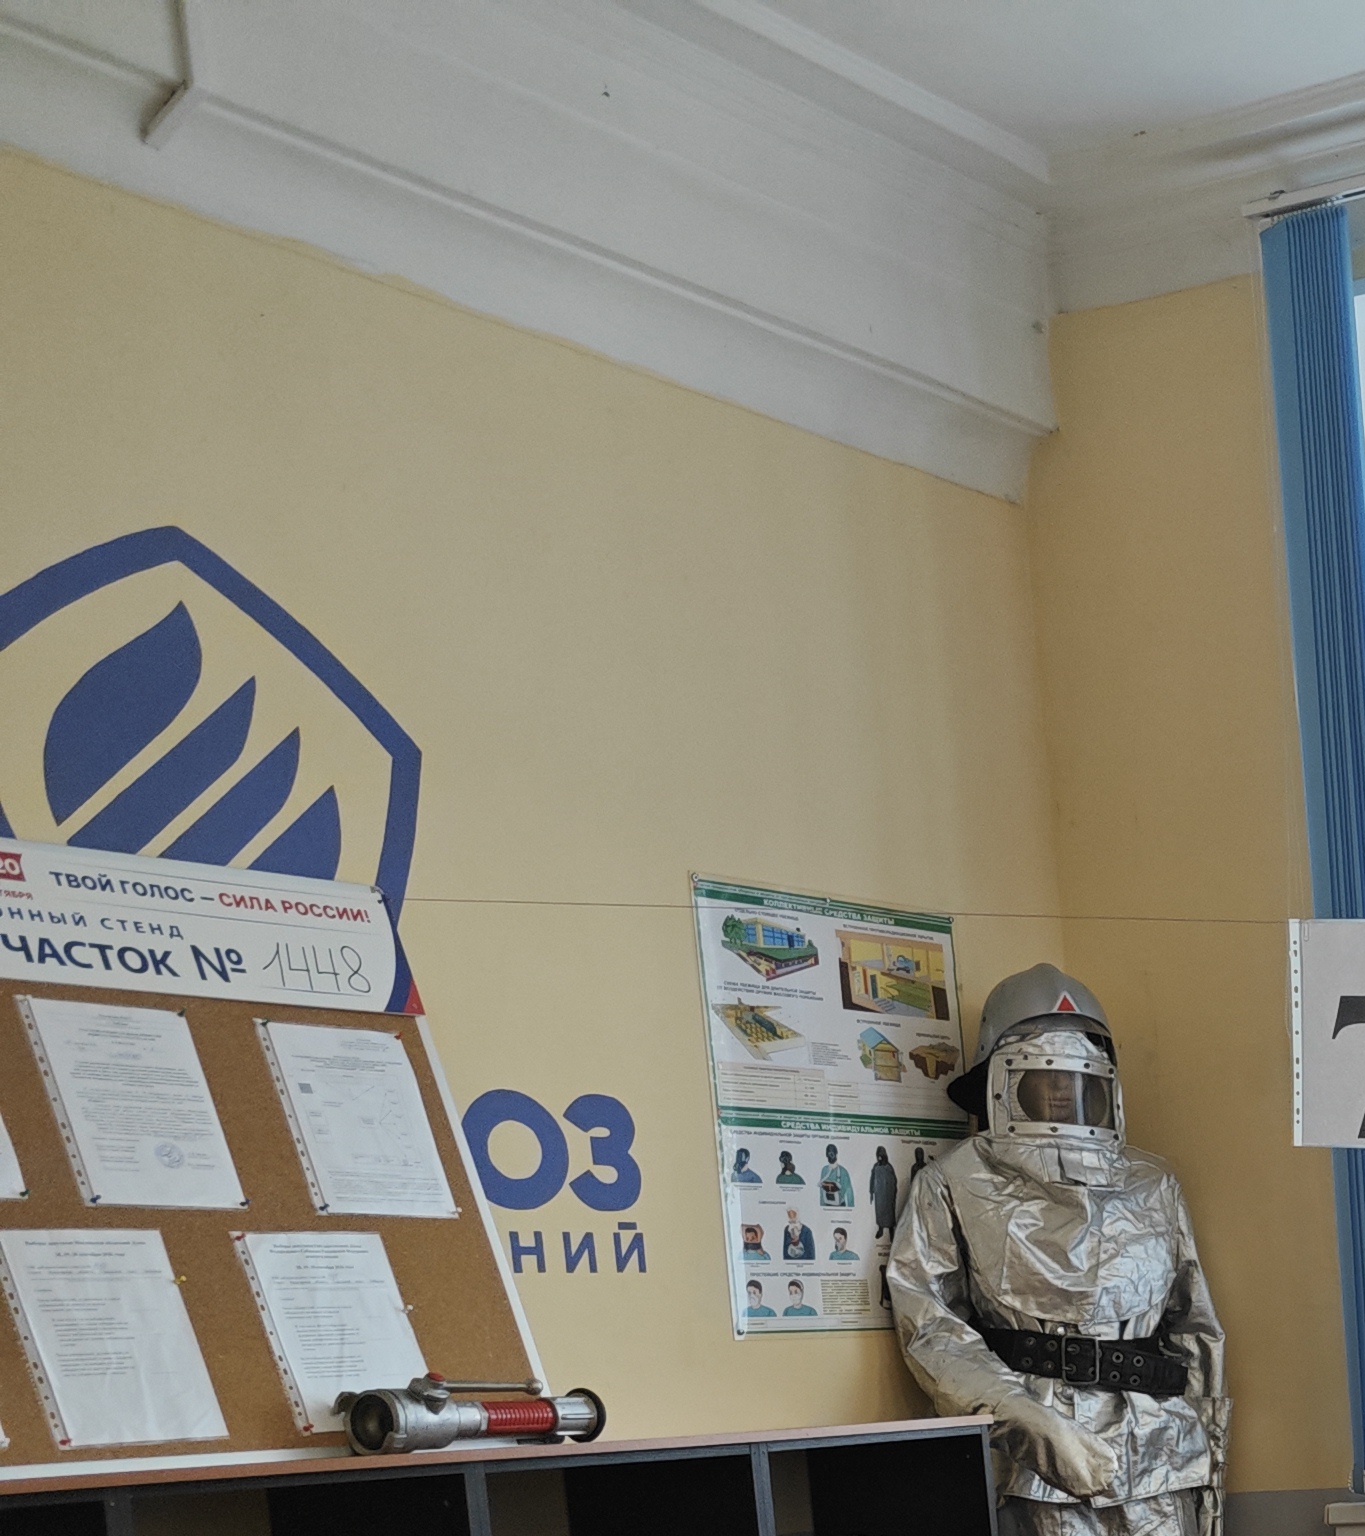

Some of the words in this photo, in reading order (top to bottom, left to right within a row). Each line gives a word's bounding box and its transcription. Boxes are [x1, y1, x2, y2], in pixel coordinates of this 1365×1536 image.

[49, 871, 115, 893] ТВОЙ
[119, 880, 195, 902] ГОЛОС
[218, 893, 278, 912] СИЛА
[281, 900, 371, 923] РОССИИ!
[825, 908, 861, 920] СРЕДСТВА
[863, 913, 895, 925] ЗАЩИТЫ
[0, 907, 87, 927] ННЫЙ
[100, 917, 184, 940] СТЕНД
[190, 944, 247, 983] №
[262, 942, 371, 993] 1448
[781, 1121, 820, 1131] СРЕДСТВА
[891, 1128, 921, 1136] ЗАЩИТЫ
[509, 1222, 647, 1273] НИЙ
